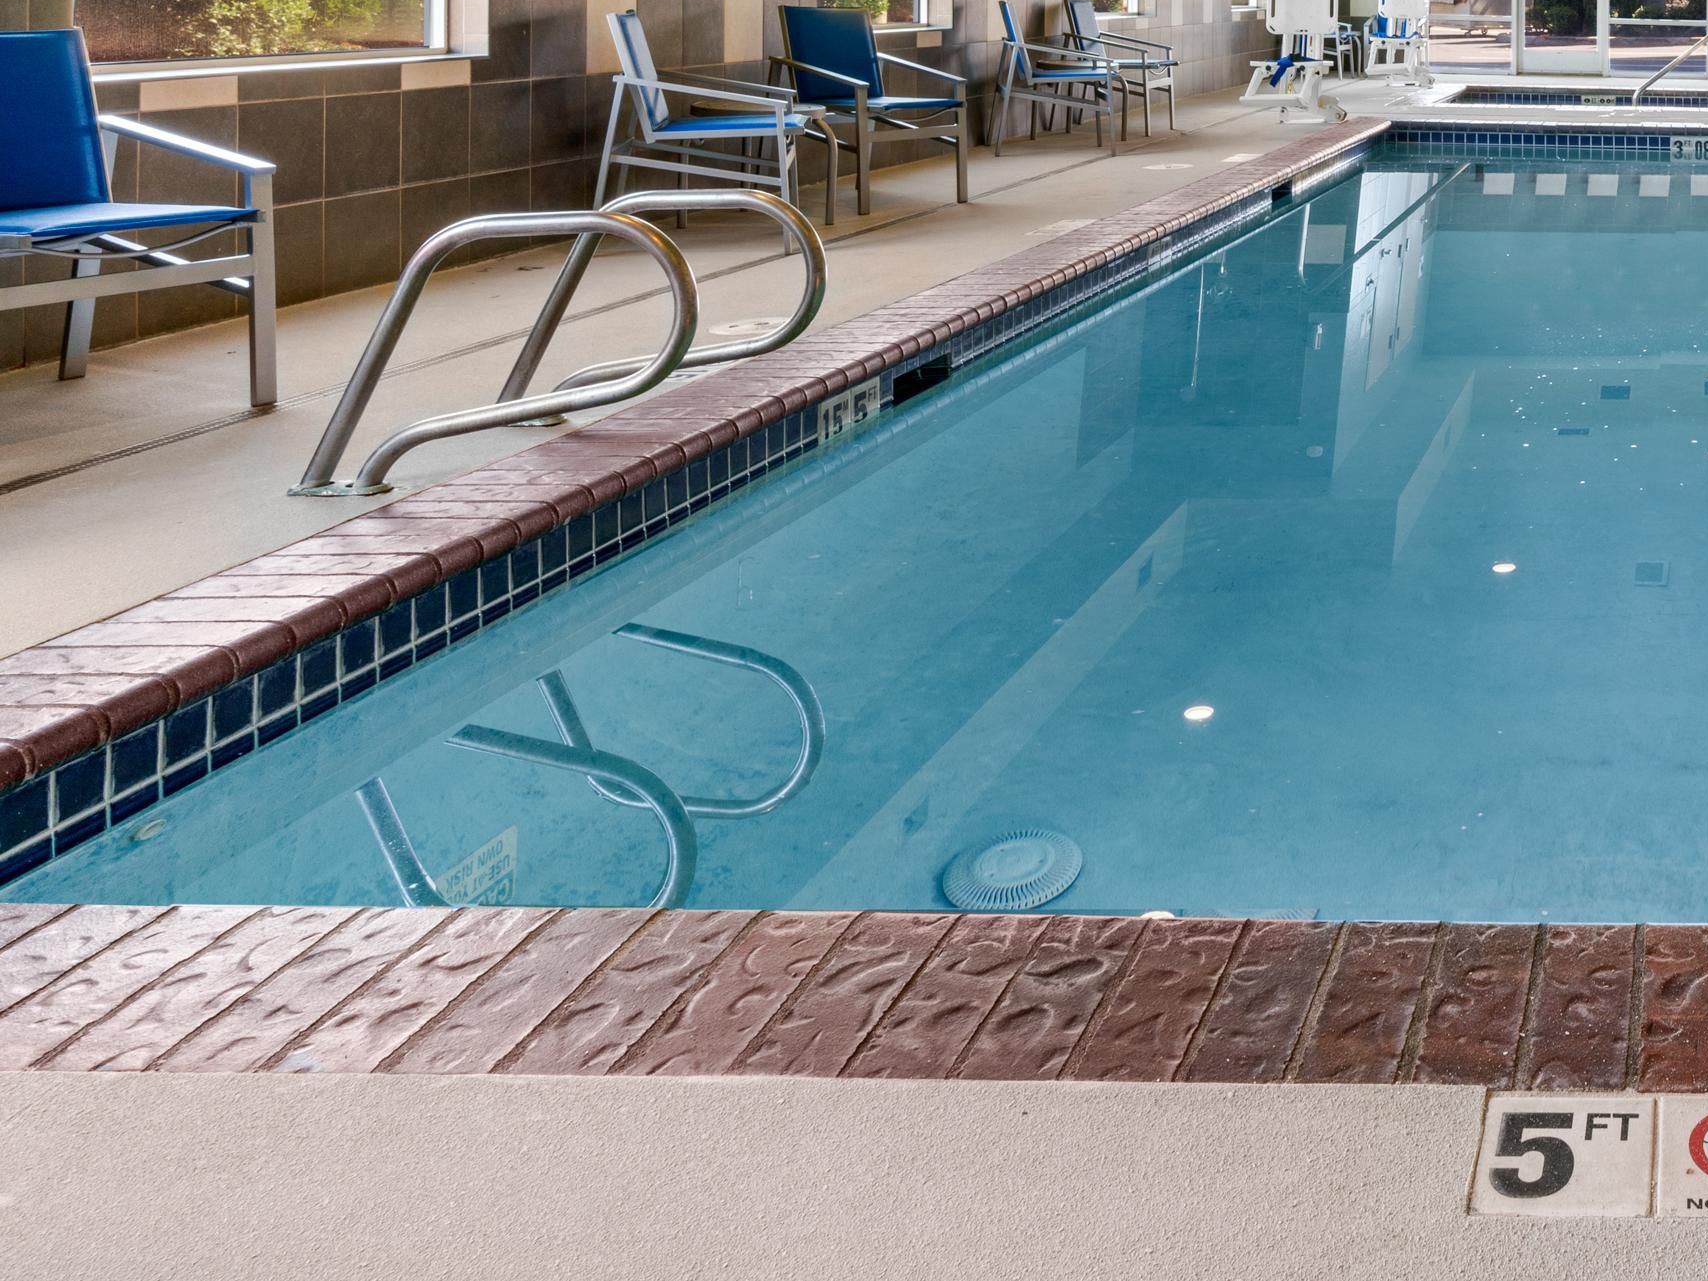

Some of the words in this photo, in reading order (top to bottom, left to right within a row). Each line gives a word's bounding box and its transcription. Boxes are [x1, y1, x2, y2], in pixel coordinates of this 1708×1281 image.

[853, 391, 869, 423] 5
[867, 385, 878, 403] FT
[1488, 1112, 1575, 1199] 5
[1584, 1113, 1640, 1141] FT
